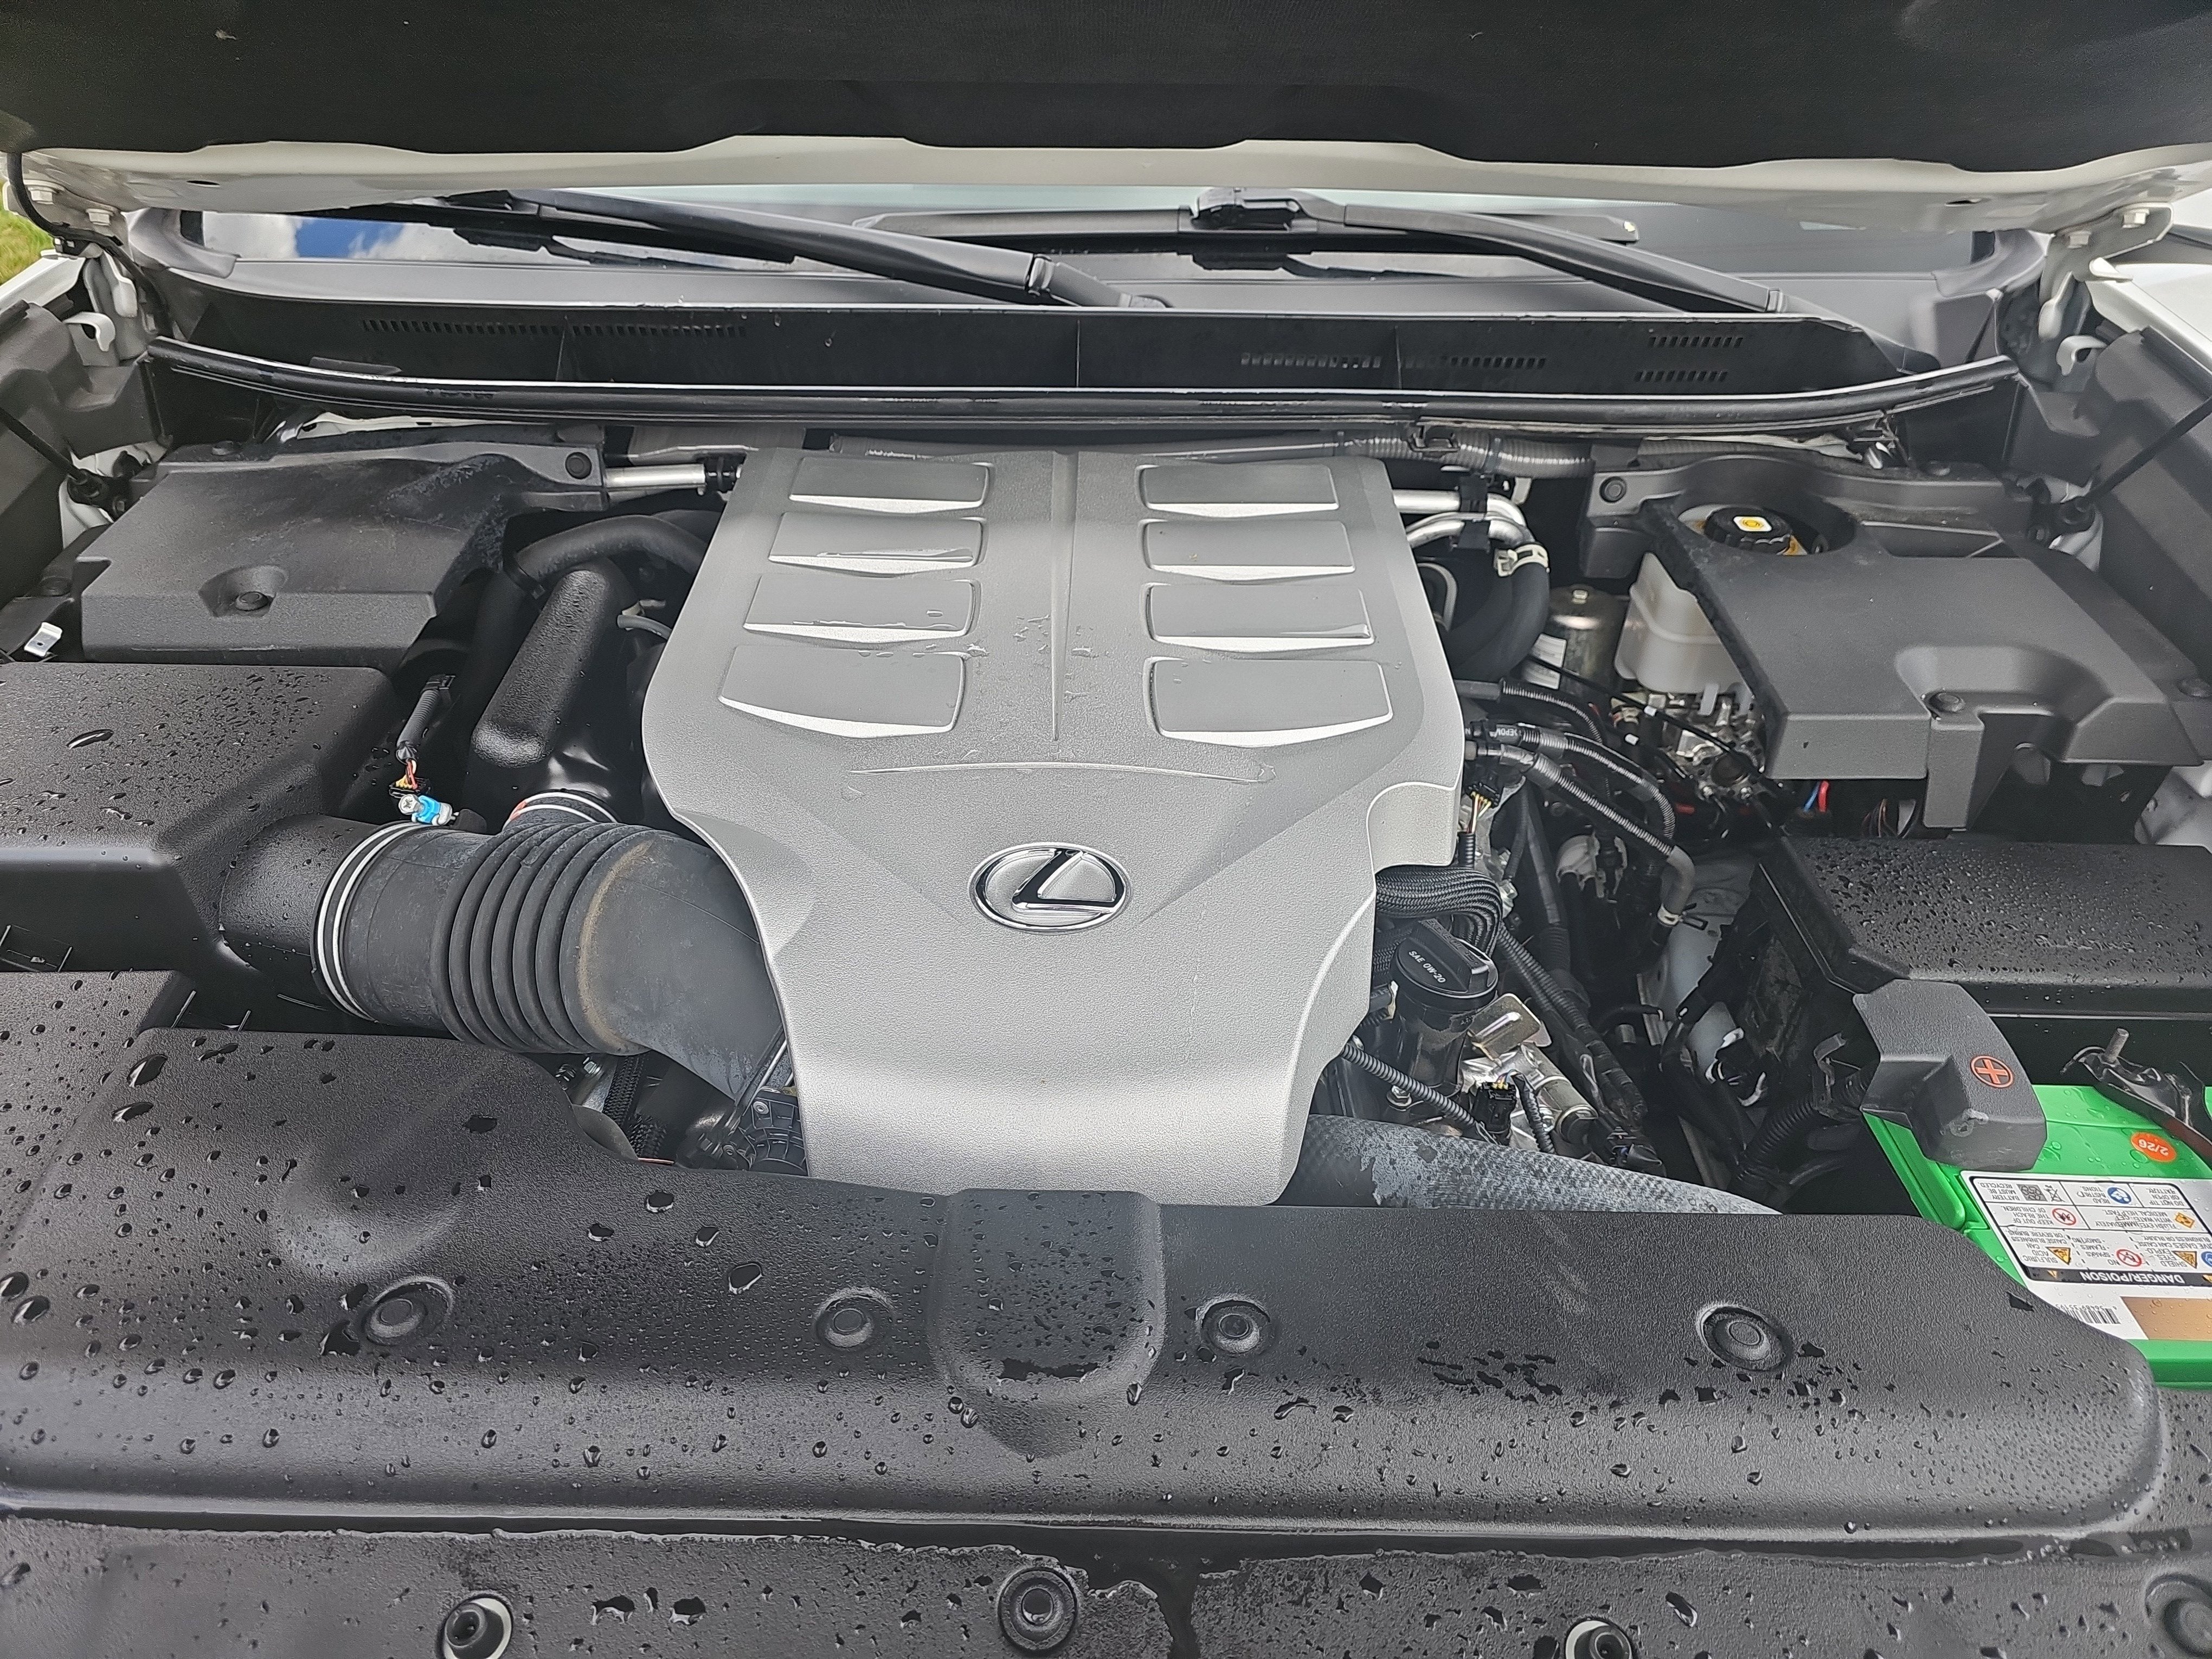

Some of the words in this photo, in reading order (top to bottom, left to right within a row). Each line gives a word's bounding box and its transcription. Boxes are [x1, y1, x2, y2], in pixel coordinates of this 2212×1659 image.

[1409, 950, 1426, 963] SAE
[1423, 963, 1446, 983] 0W-20
[2138, 1139, 2169, 1157] 2/26
[2022, 1255, 2058, 1263] SULFURIC
[2080, 1271, 2185, 1284] DANGER/POISON
